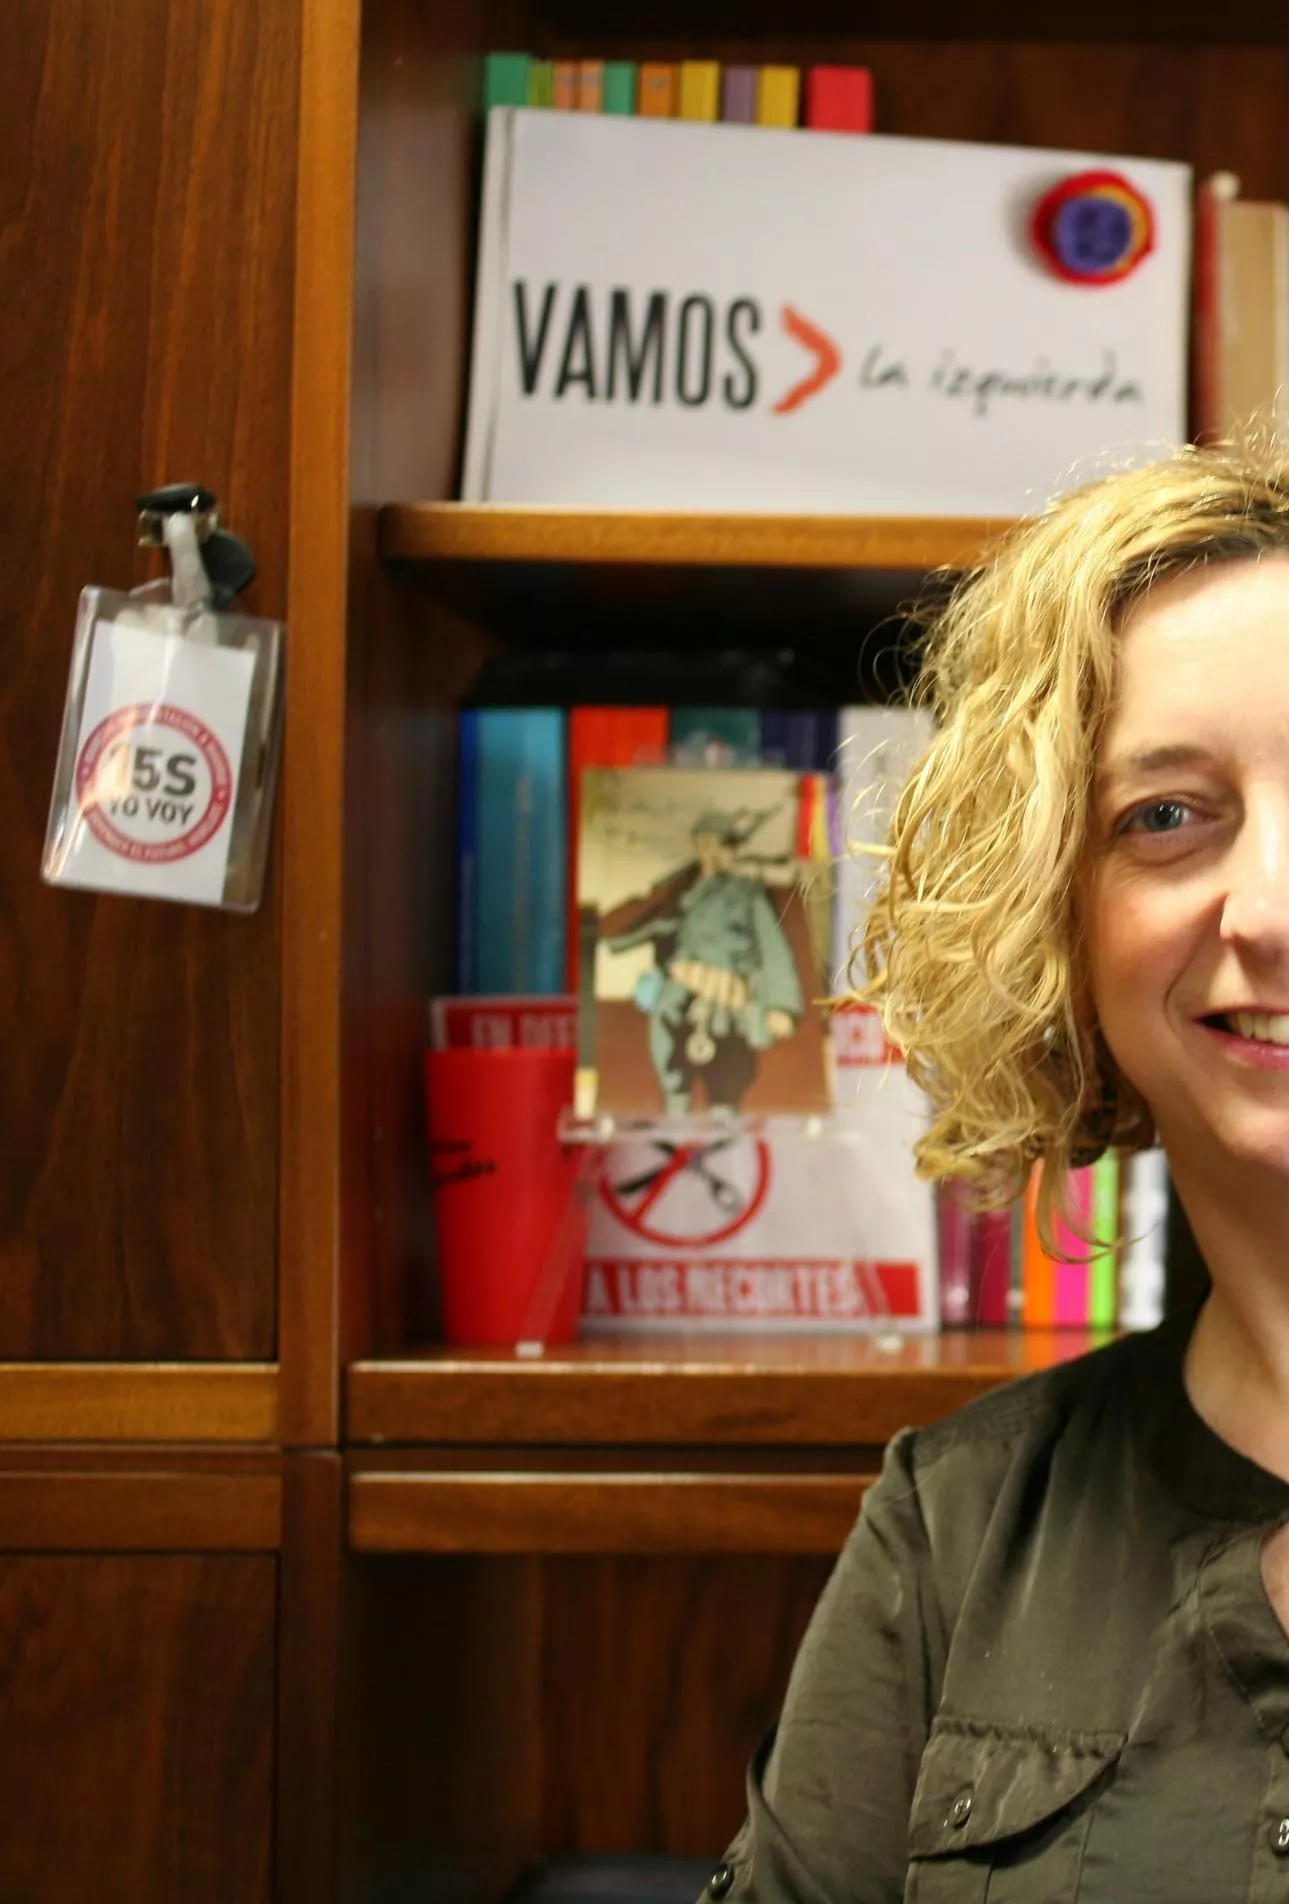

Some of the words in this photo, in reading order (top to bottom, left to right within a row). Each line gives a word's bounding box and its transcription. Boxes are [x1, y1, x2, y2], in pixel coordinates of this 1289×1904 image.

[513, 279, 763, 413] VAMOS
[930, 346, 1144, 419] izquierda
[146, 798, 195, 827] VOY
